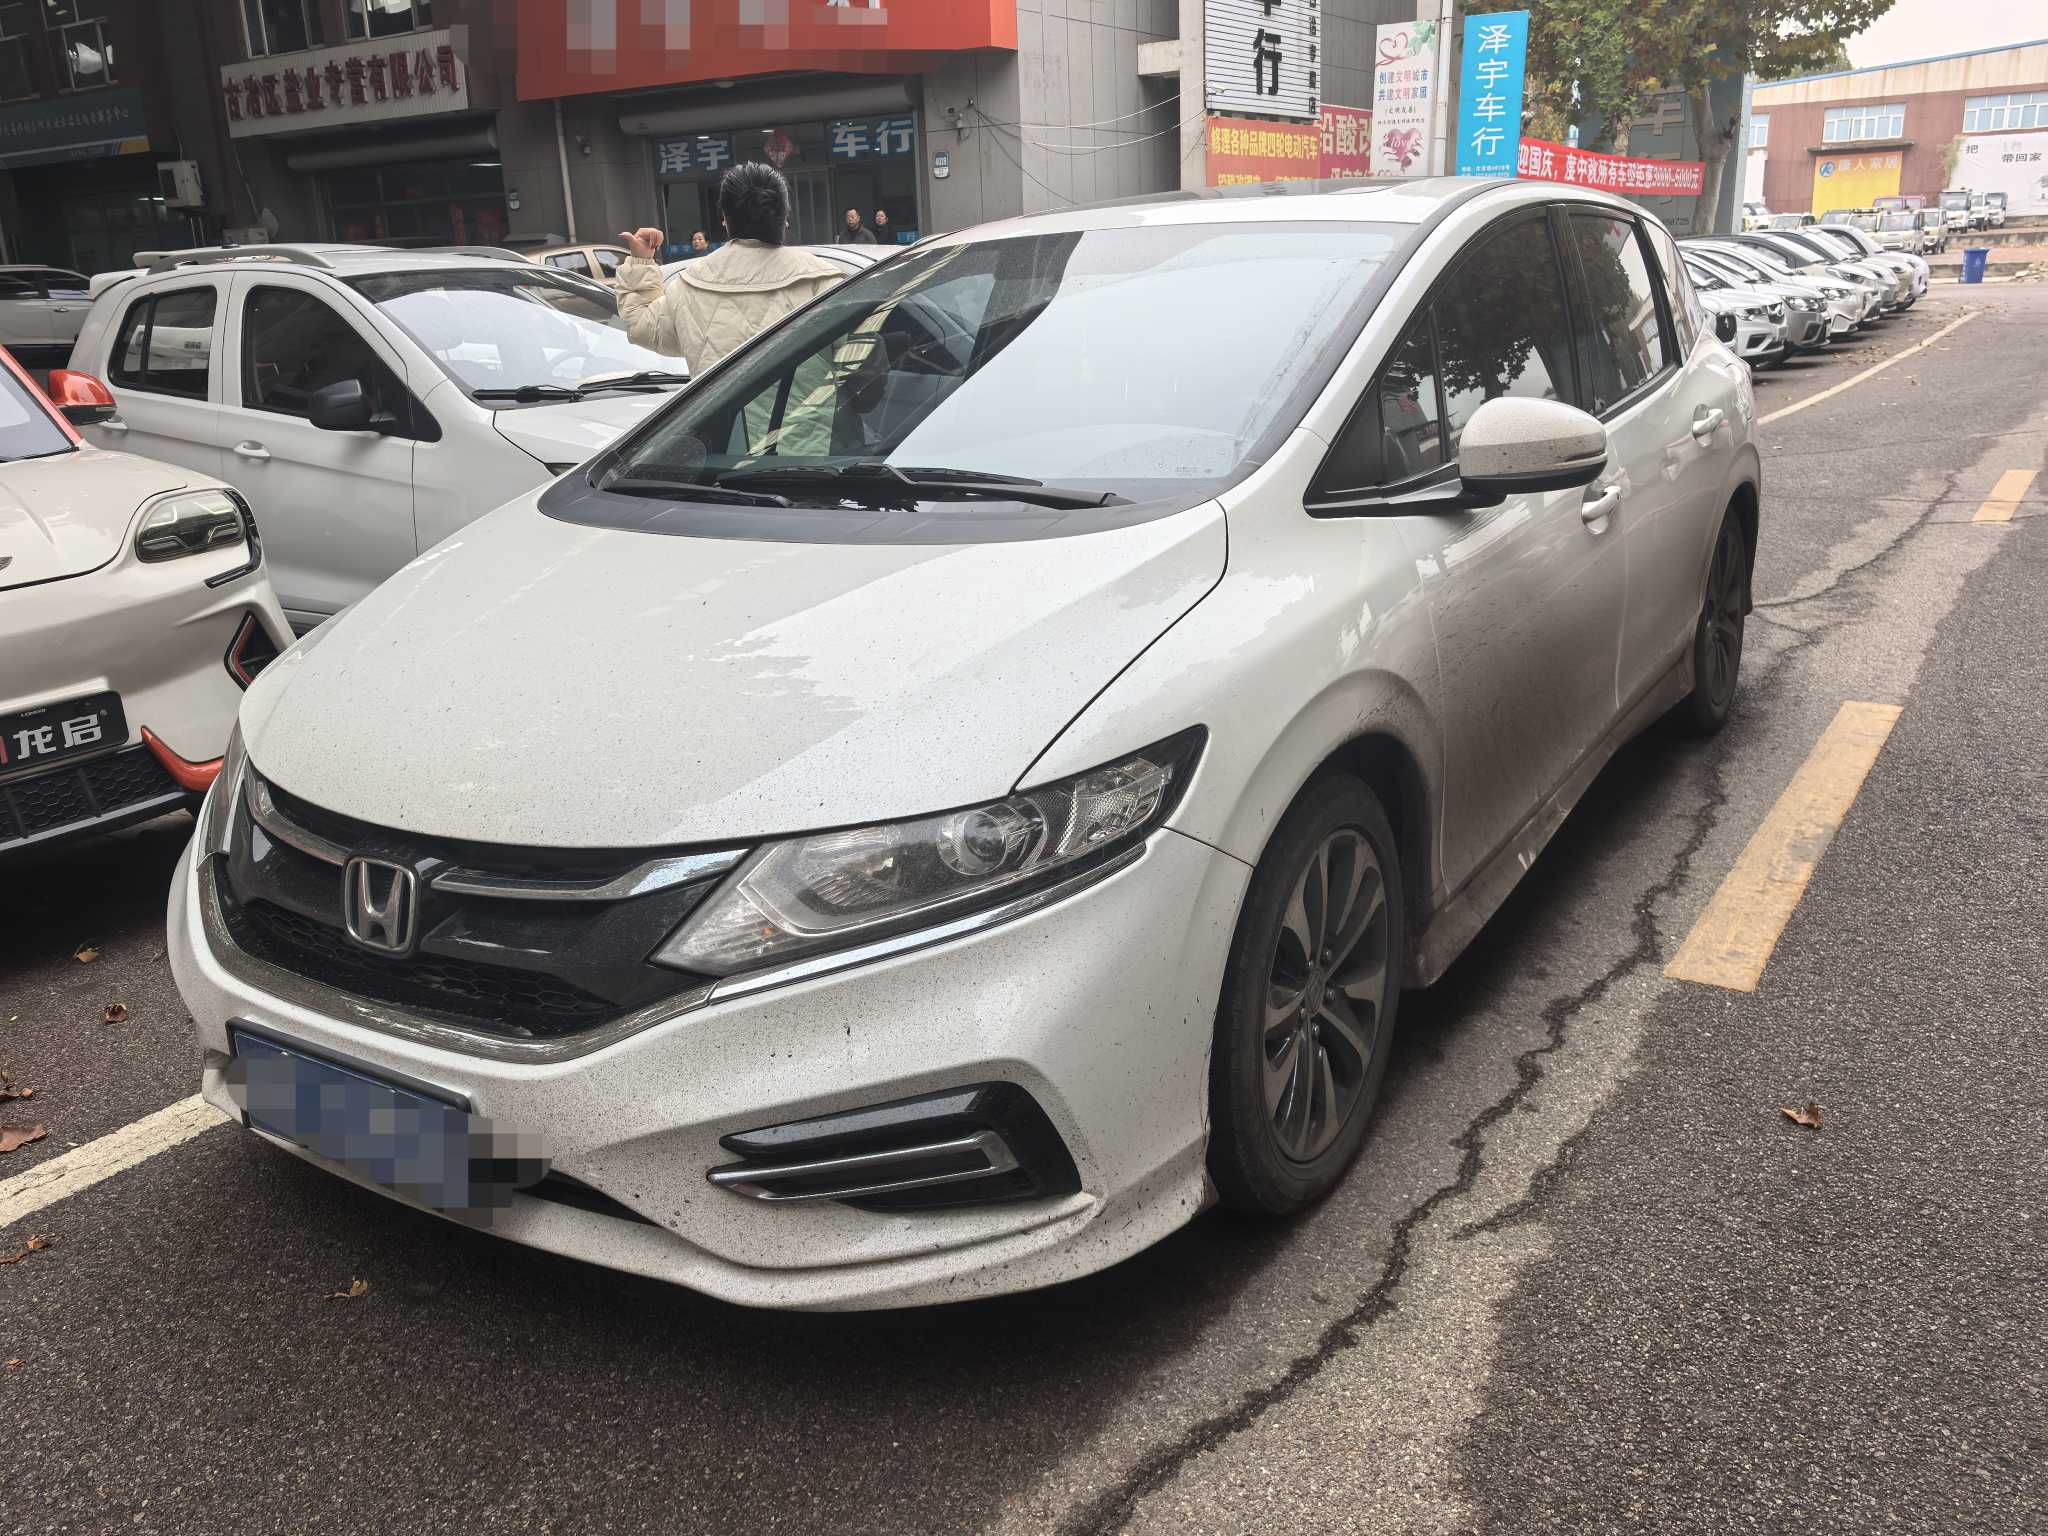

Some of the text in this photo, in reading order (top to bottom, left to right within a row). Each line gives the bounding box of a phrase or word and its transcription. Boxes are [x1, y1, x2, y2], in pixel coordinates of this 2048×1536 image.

[1253, 0, 1282, 95] 行
[1378, 86, 1428, 102] 共建文明家园
[1379, 69, 1429, 85] 创建文明城市
[1471, 24, 1512, 156] 泽宇车行
[659, 139, 729, 174] 泽宇
[833, 120, 913, 157] 车行
[1211, 126, 1318, 160] 修理各种品牌四轮电动汽车
[2001, 152, 2043, 163] 带回家
